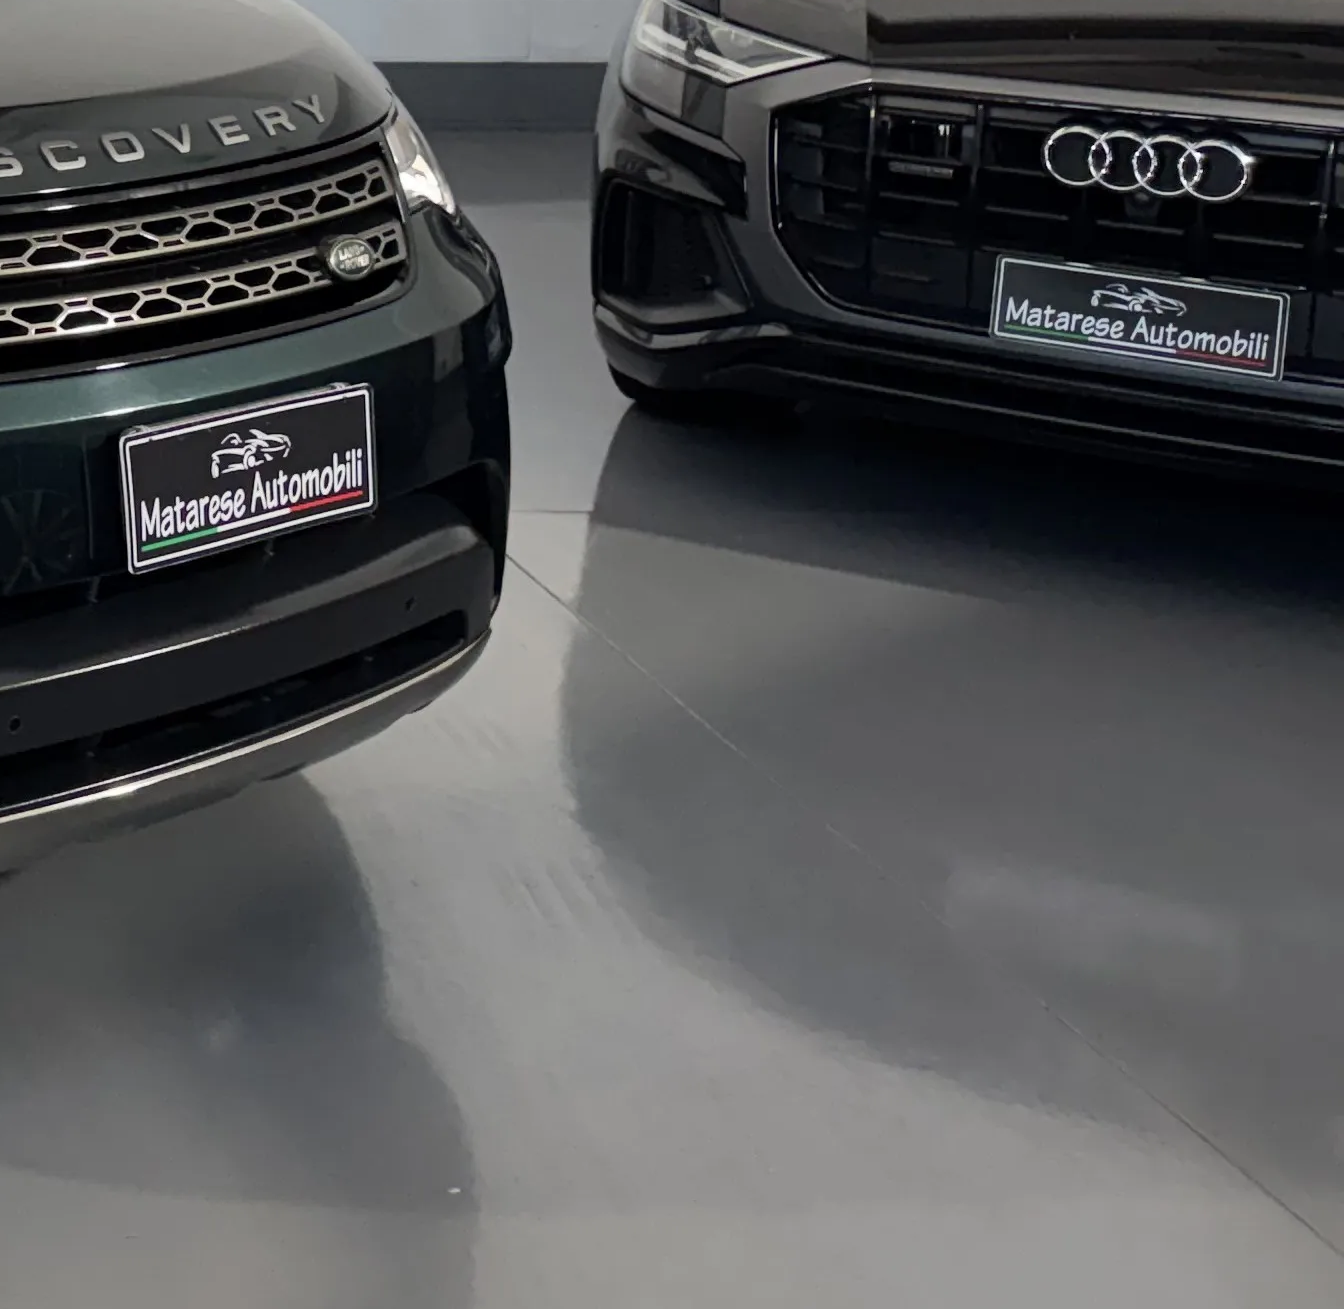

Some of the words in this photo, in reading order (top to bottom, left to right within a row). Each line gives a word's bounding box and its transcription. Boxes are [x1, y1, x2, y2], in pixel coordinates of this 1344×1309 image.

[1005, 296, 1125, 339] Matarese
[1130, 314, 1270, 361] Automobili
[140, 485, 246, 542] Matarese
[250, 447, 363, 513] Automobili
